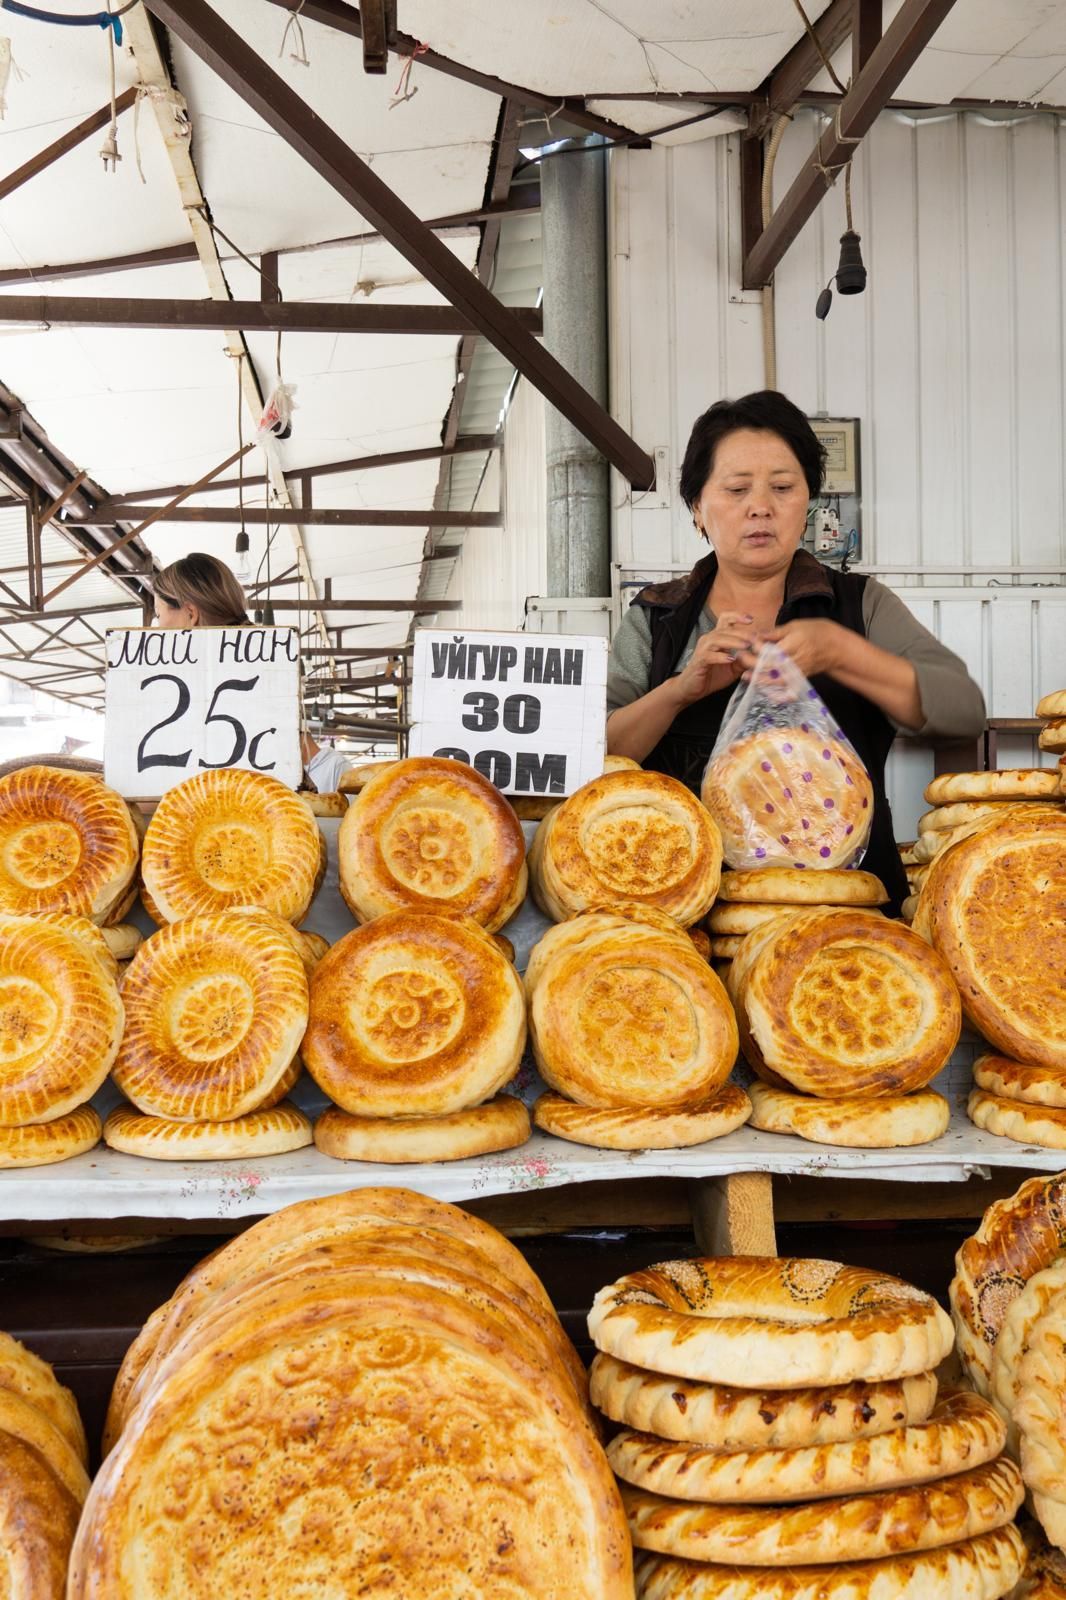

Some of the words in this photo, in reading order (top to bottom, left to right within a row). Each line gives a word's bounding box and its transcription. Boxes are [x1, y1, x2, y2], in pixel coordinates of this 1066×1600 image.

[431, 636, 517, 682] УЙГУР
[523, 646, 584, 685] НАН
[462, 691, 541, 734] 30
